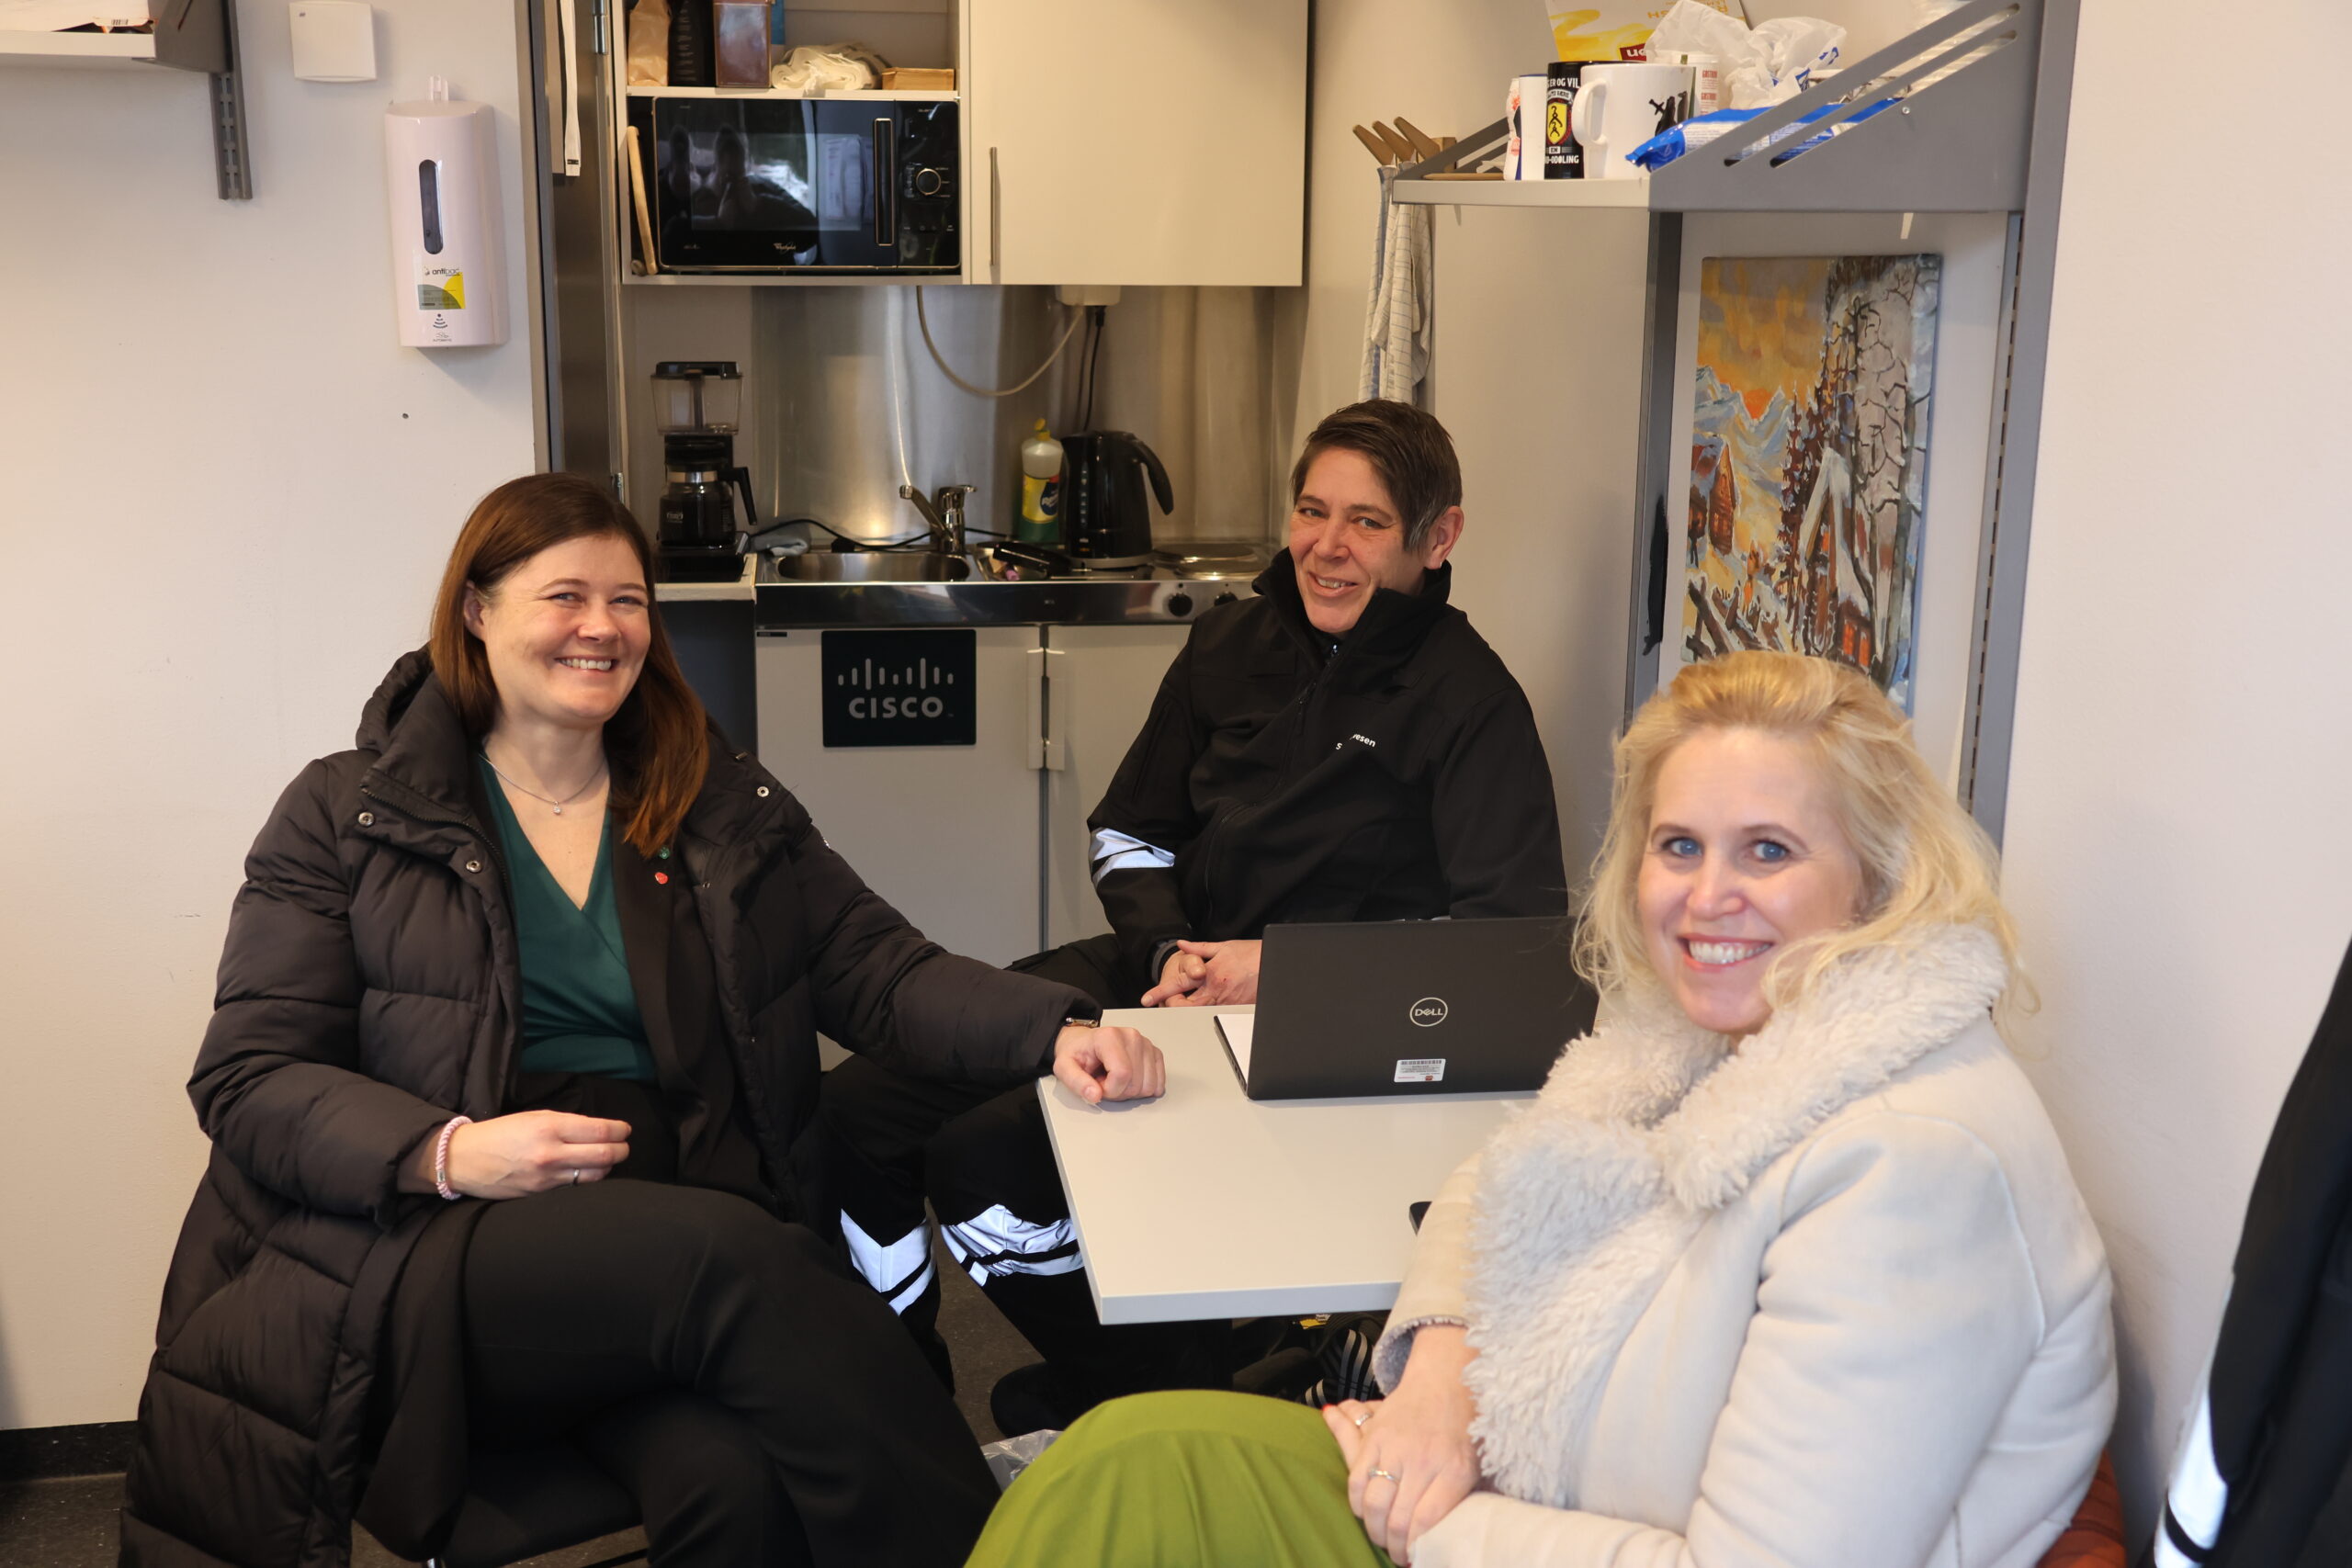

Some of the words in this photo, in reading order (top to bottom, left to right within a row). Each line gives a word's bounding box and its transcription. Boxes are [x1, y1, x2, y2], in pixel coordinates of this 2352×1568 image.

[1556, 77, 1566, 87] OG
[1566, 77, 1581, 88] VIL
[848, 696, 944, 719] CISCO
[1415, 1008, 1443, 1017] DELL
